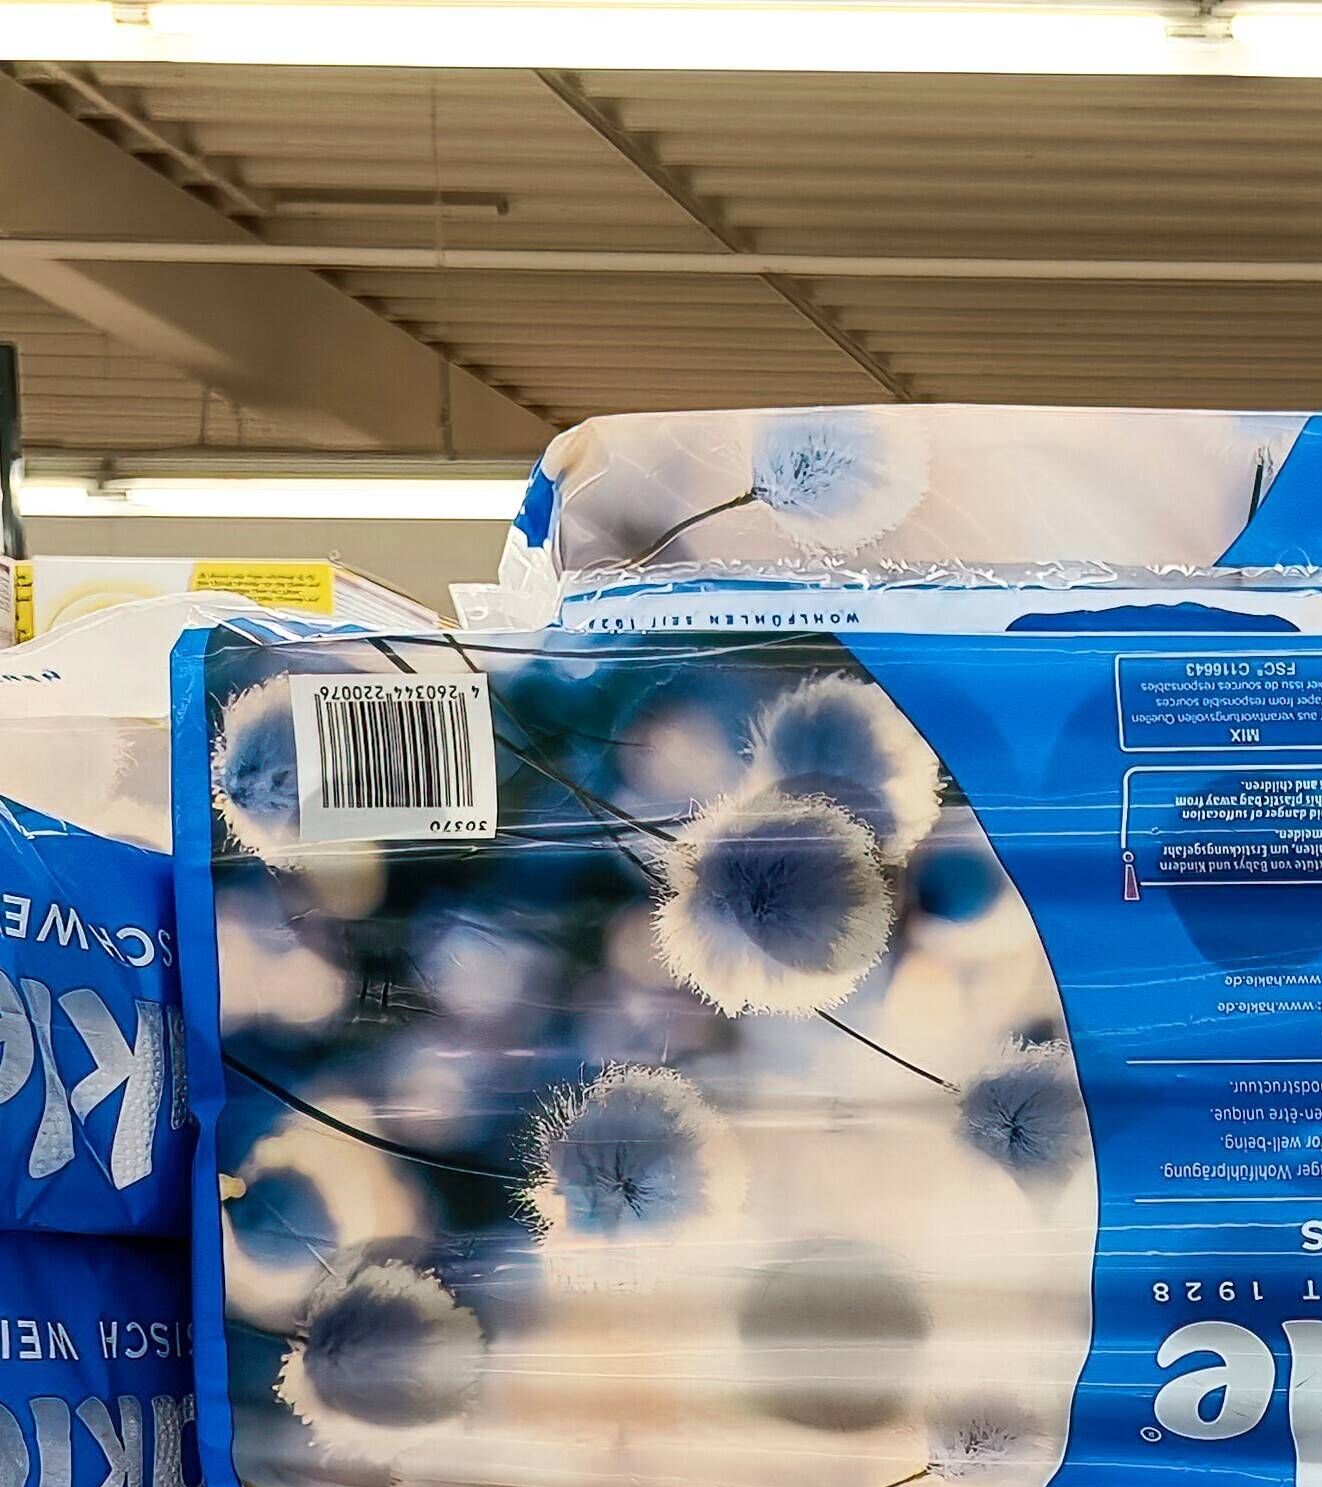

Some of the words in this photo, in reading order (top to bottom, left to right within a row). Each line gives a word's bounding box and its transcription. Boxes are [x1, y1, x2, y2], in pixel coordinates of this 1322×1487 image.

[320, 686, 384, 699] 220076
[394, 685, 457, 699] 260344
[471, 686, 480, 698] 4
[430, 821, 488, 831] 30370
[1211, 1106, 1264, 1123] unique.
[1220, 1134, 1301, 1152] well-being.
[1160, 1163, 1292, 1181] Wohlfühlprägung.
[1151, 1281, 1261, 1303] 1928
